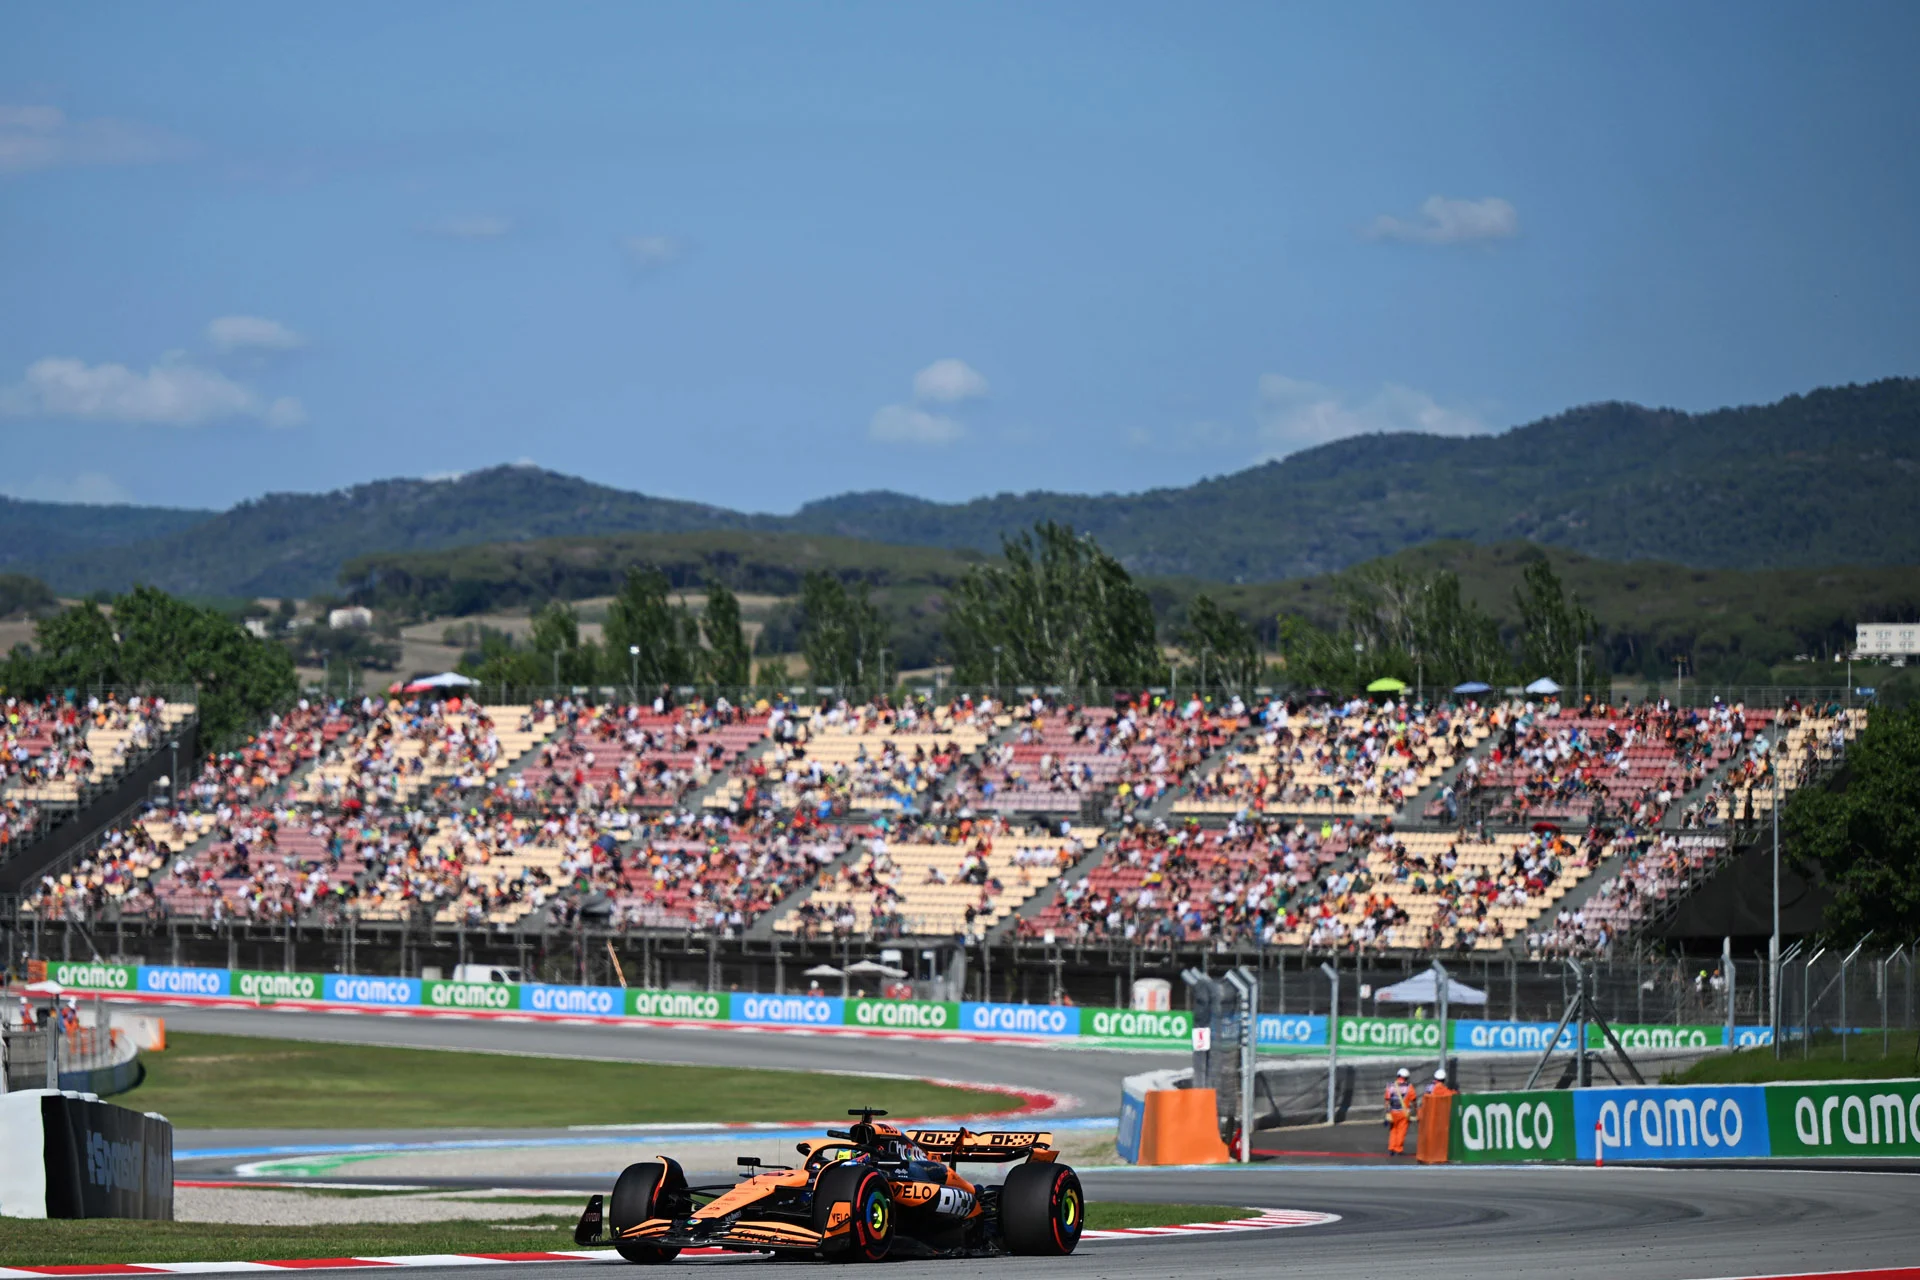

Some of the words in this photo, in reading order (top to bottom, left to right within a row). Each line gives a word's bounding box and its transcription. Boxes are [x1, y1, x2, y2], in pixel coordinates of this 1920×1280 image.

[57, 965, 128, 989] aramco
[147, 971, 220, 993] aramco
[240, 974, 315, 998] aramco
[335, 979, 410, 1002] aramco
[431, 984, 510, 1008] aramco
[532, 989, 612, 1012] aramco
[636, 993, 720, 1018] aramco
[744, 998, 831, 1022] aramco
[856, 1002, 947, 1027] aramco
[974, 1007, 1067, 1032] aramco
[1093, 1012, 1188, 1037] aramco
[1341, 1021, 1440, 1046] aramco
[1471, 1026, 1572, 1049] aramco
[1601, 1099, 1742, 1147] aramco
[889, 1140, 929, 1162] Chrome
[890, 1184, 932, 1200] VELO
